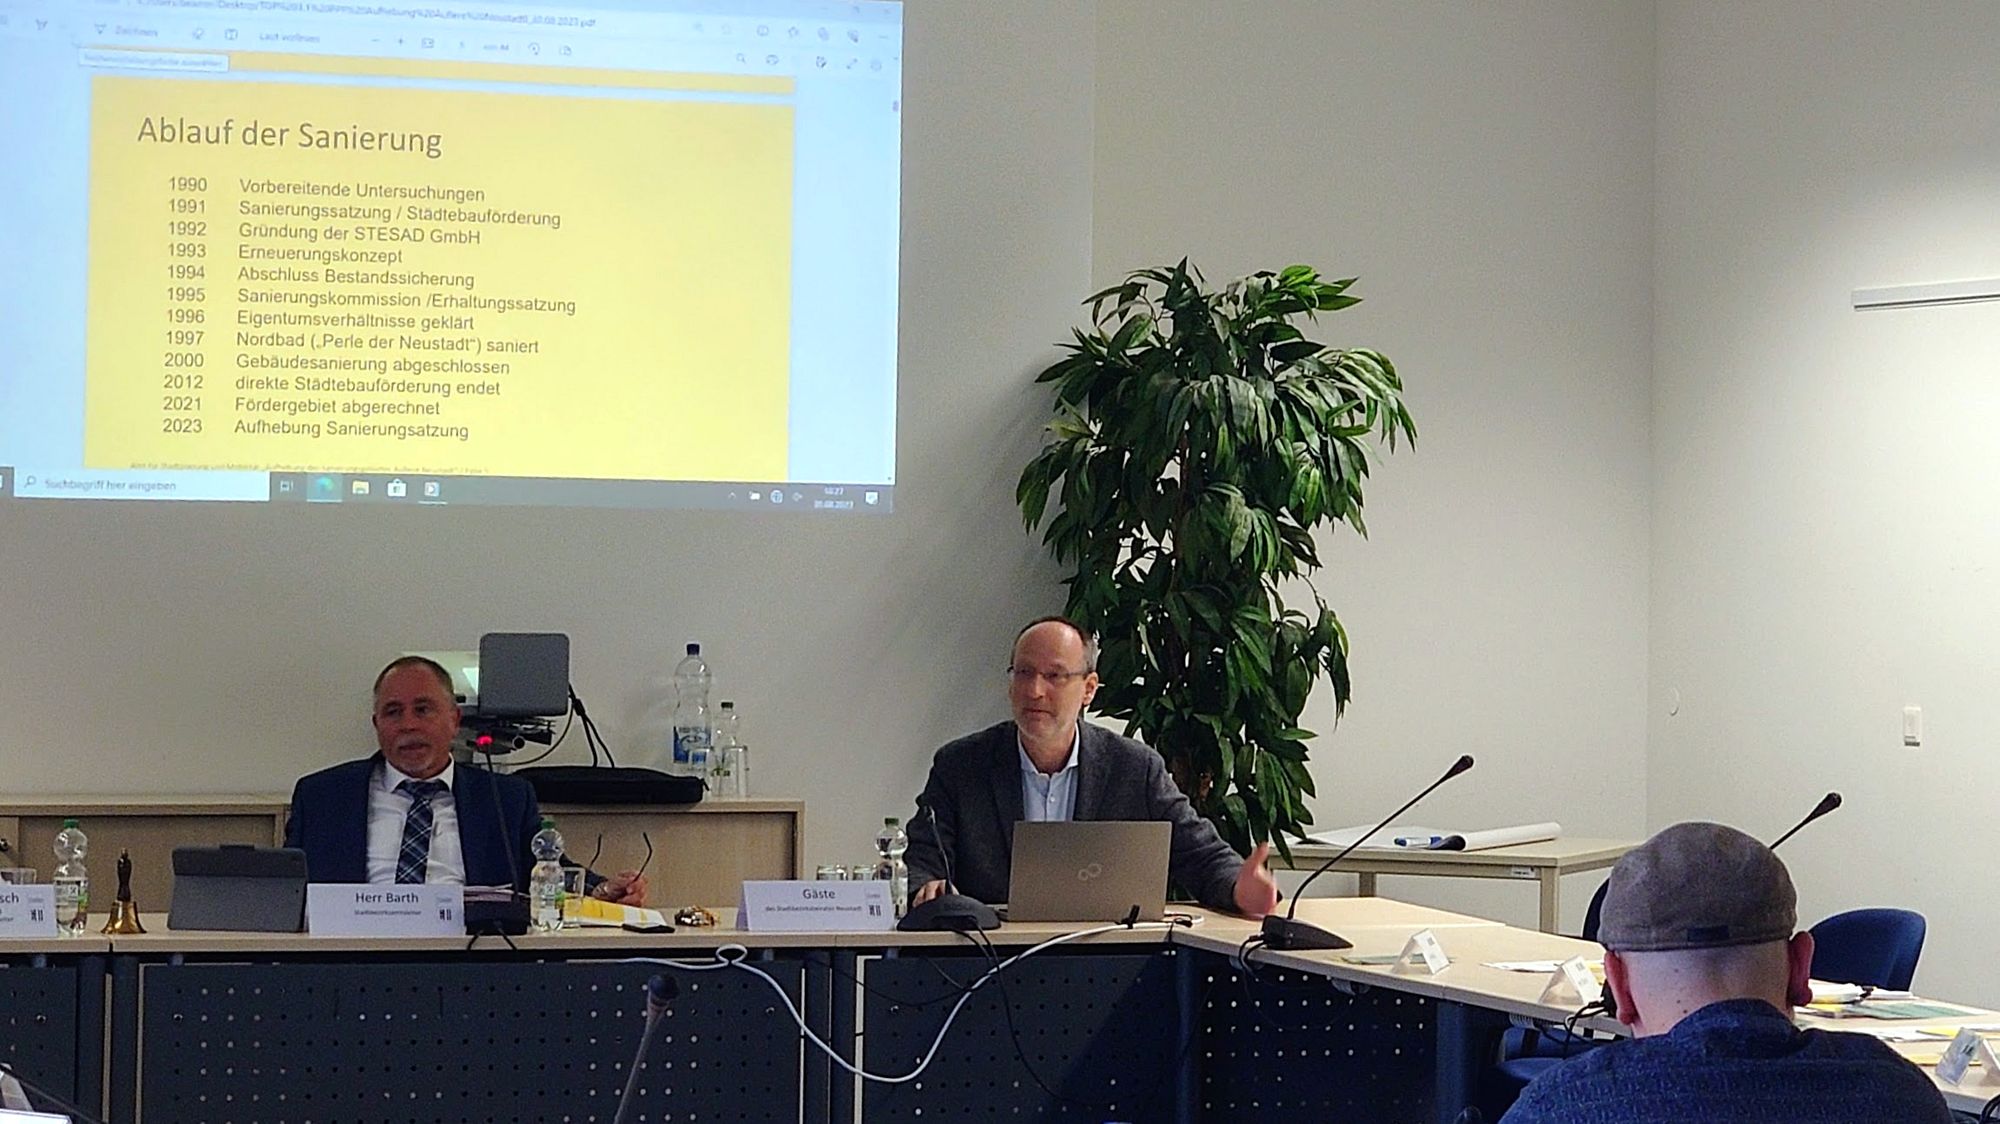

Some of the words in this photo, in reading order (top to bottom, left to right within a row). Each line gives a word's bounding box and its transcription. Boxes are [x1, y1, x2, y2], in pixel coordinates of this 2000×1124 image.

[137, 116, 235, 146] Ablauf
[241, 120, 290, 147] der
[299, 122, 443, 159] Sanierung
[169, 177, 207, 193] 1990
[240, 179, 350, 197] Vorbereitende
[356, 183, 485, 203] Untersuchungen
[169, 199, 206, 215] 1991
[239, 201, 391, 222] Sanierungssatzung
[406, 205, 561, 229] Städtebauförderung
[168, 221, 207, 237] 1992
[239, 222, 317, 242] Gründung
[324, 225, 349, 240] der
[354, 226, 425, 243] STESAD
[430, 229, 481, 244] GmbH
[168, 243, 206, 259] 1993
[239, 244, 403, 265] Erneuerungskonzept
[168, 265, 206, 280] 1994
[238, 267, 319, 283] Abschluss
[325, 269, 475, 289] Bestandssicherung
[167, 287, 206, 303] 1995
[238, 288, 421, 308] Sanierungskommission
[167, 309, 205, 325] 1996
[237, 310, 415, 330] Eigentumsverhältnisse
[421, 314, 474, 333] geklärt
[166, 331, 204, 346] 1997
[236, 332, 305, 349] Nordbad
[369, 335, 393, 351] der
[486, 338, 539, 355] saniert
[164, 353, 204, 368] 2000
[236, 353, 387, 374] Gebäudesanierung
[393, 357, 510, 376] abgeschlossen
[163, 375, 203, 390] 2012
[235, 375, 289, 392] direkte
[295, 376, 451, 397] Städtebauförderung
[456, 379, 501, 395] endet
[163, 397, 202, 412] 2021
[235, 398, 337, 417] Fördergebiet
[342, 400, 440, 418] abgerechnet
[162, 419, 203, 434] 2023
[235, 420, 321, 439] Aufhebung
[326, 421, 469, 441] Sanierungsatzung
[45, 479, 104, 492] Suchbegriff
[106, 480, 126, 490] hier
[129, 481, 176, 493] eingeben
[356, 893, 382, 903] Herr
[386, 893, 419, 903] Barth
[803, 888, 836, 899] Gäste
